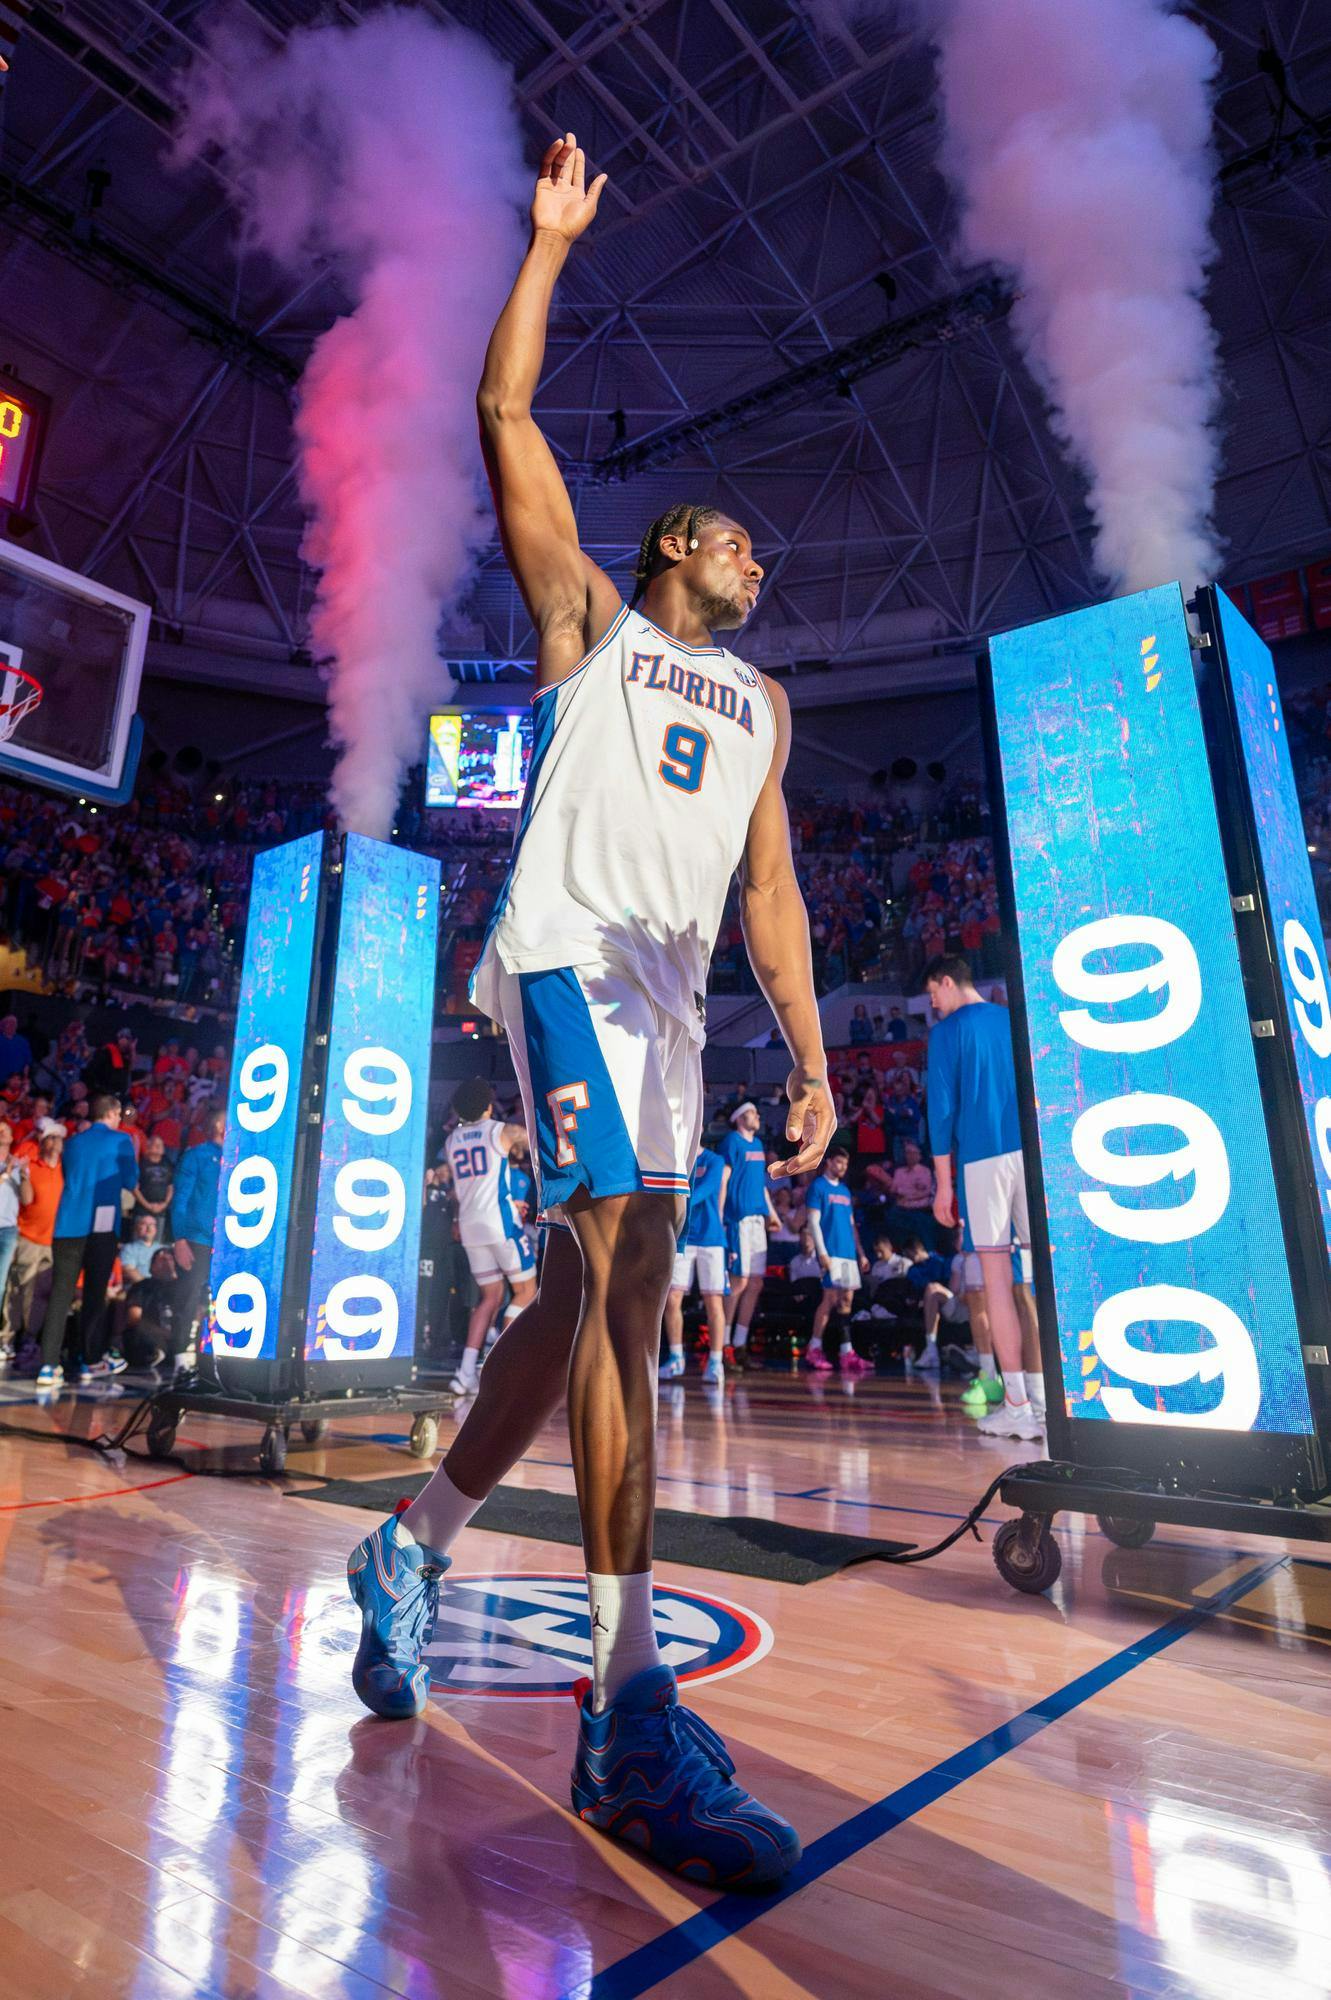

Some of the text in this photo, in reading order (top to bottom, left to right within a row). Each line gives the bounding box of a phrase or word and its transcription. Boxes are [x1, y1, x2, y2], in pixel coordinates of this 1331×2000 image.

[626, 651, 754, 737] FLORIDA
[658, 721, 710, 794] 9
[1052, 913, 1202, 1053] 9
[1283, 919, 1331, 1058] 9
[237, 1043, 289, 1132] 9
[342, 1046, 412, 1135] 9
[546, 1081, 590, 1168] F
[225, 1155, 278, 1249] 9
[333, 1158, 406, 1252] 9
[453, 1146, 488, 1179] 20
[1072, 1092, 1231, 1243] 9
[212, 1272, 267, 1359] 9
[322, 1274, 399, 1361] 9
[1092, 1284, 1261, 1432] 9
